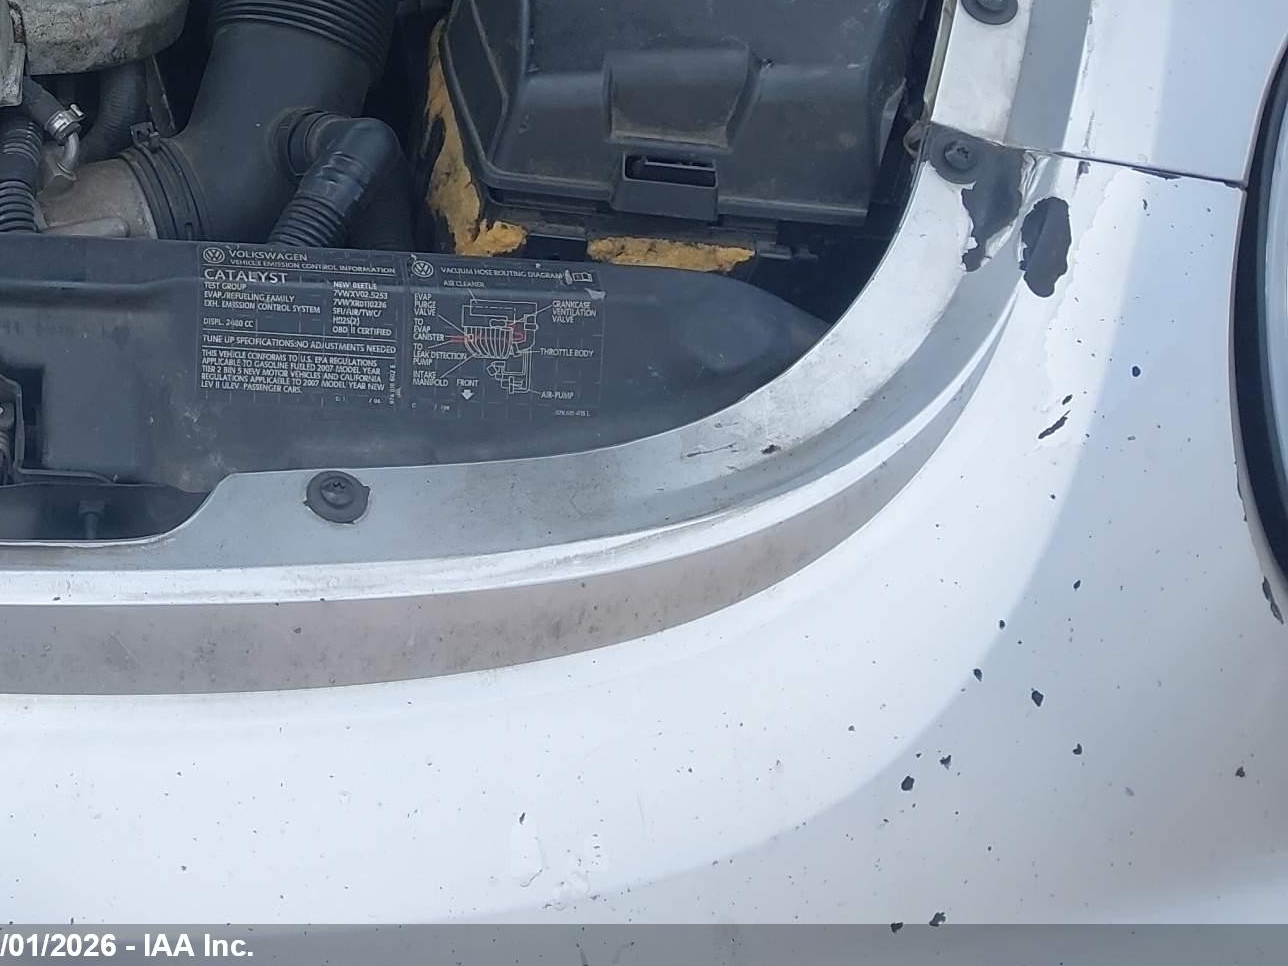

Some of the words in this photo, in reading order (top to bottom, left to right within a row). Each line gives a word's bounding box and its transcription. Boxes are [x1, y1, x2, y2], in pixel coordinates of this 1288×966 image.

[229, 250, 308, 261] VOLKSWAGEN
[263, 260, 300, 268] EMISSION
[302, 262, 338, 271] CONTROL
[339, 265, 396, 274] INFORMATION
[204, 268, 288, 284] CATALYST
[440, 266, 472, 274] VACUUM
[527, 271, 562, 279] DIAGRAM
[204, 281, 220, 289] TEST
[222, 282, 246, 290] GROUP
[352, 282, 377, 290] BEETLE
[266, 294, 295, 303] FAMILY
[204, 300, 220, 308] EXH.
[222, 301, 256, 309] EMISSION
[257, 303, 290, 312] CONTROL
[292, 304, 320, 314] SYSTEM
[414, 300, 436, 308] PURGE
[552, 300, 591, 308] CRANKCASE
[552, 308, 596, 316] VENTILATION
[204, 318, 224, 326] DISPL.
[414, 318, 424, 326] TO
[552, 315, 574, 324] VALVE
[357, 327, 392, 336] CERTIFIED
[413, 333, 444, 342] CANISTER
[202, 334, 222, 343] TUNE
[224, 336, 236, 344] UP
[310, 341, 364, 352] ADJUSTMENTS
[366, 344, 396, 354] NEEDED
[414, 342, 423, 350] TO
[430, 352, 467, 360] DETECTION
[540, 348, 573, 356] THROTTLE
[574, 349, 594, 357] BODY
[219, 350, 246, 358] VEHICLE
[248, 352, 286, 362] CONFORMS
[314, 356, 328, 364] EPA
[329, 357, 378, 367] REGULATIONS
[413, 358, 432, 366] PUMP
[202, 357, 241, 366] APPLICABLE
[254, 360, 288, 370] GASOLINE
[290, 363, 316, 372] FUELED
[317, 364, 334, 372] 2007
[336, 366, 360, 374] MODEL
[362, 367, 380, 375] YEAR
[262, 369, 288, 378] MOTOR
[290, 370, 320, 380] VEHICLES
[323, 372, 338, 380] AND
[340, 374, 382, 383] CALIFORNIA
[413, 370, 436, 379] INTAKE
[202, 372, 248, 382] REGULATIONS
[250, 375, 290, 385] APPLICABLE
[302, 379, 320, 387] 2007
[321, 380, 346, 388] MODEL
[348, 382, 366, 390] YEAR
[368, 383, 385, 391] NEW
[412, 378, 448, 386] MANIFOLD
[456, 378, 479, 386] FRONT
[222, 382, 240, 390] ULEV
[243, 382, 282, 392] PASSENGER
[282, 385, 302, 394] CARS.
[541, 390, 574, 400] AIR-PUMP
